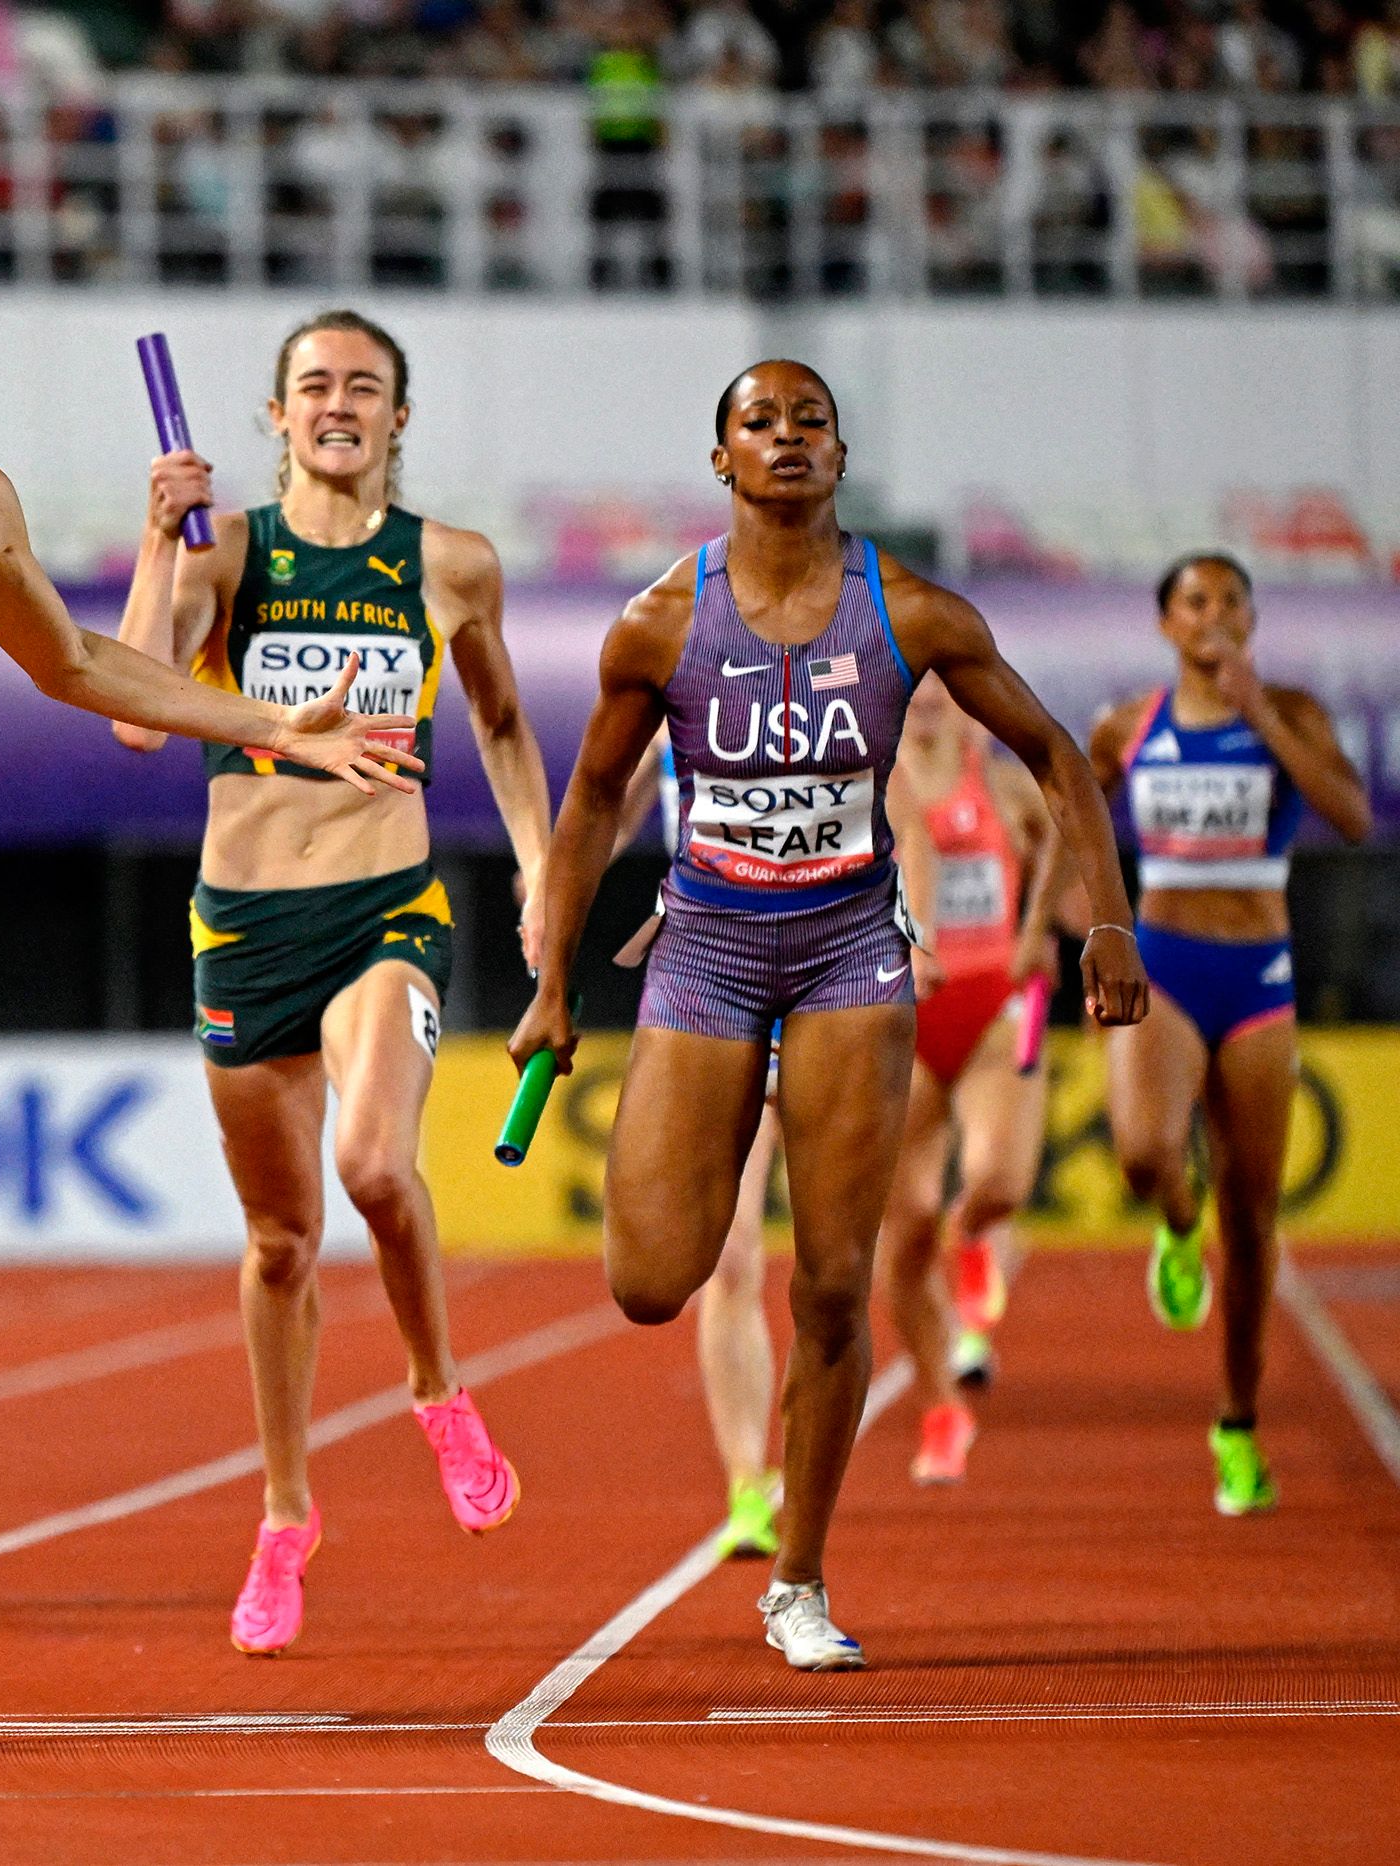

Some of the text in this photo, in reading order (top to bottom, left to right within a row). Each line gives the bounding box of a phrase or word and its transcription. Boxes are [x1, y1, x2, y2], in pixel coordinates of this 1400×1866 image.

[256, 598, 411, 635] SOUTH AFRICA
[260, 643, 408, 673] SONY
[707, 696, 869, 764] USA
[708, 779, 855, 813] SONY
[718, 819, 843, 859] LEAR
[734, 861, 842, 883] GUANGZHOU
